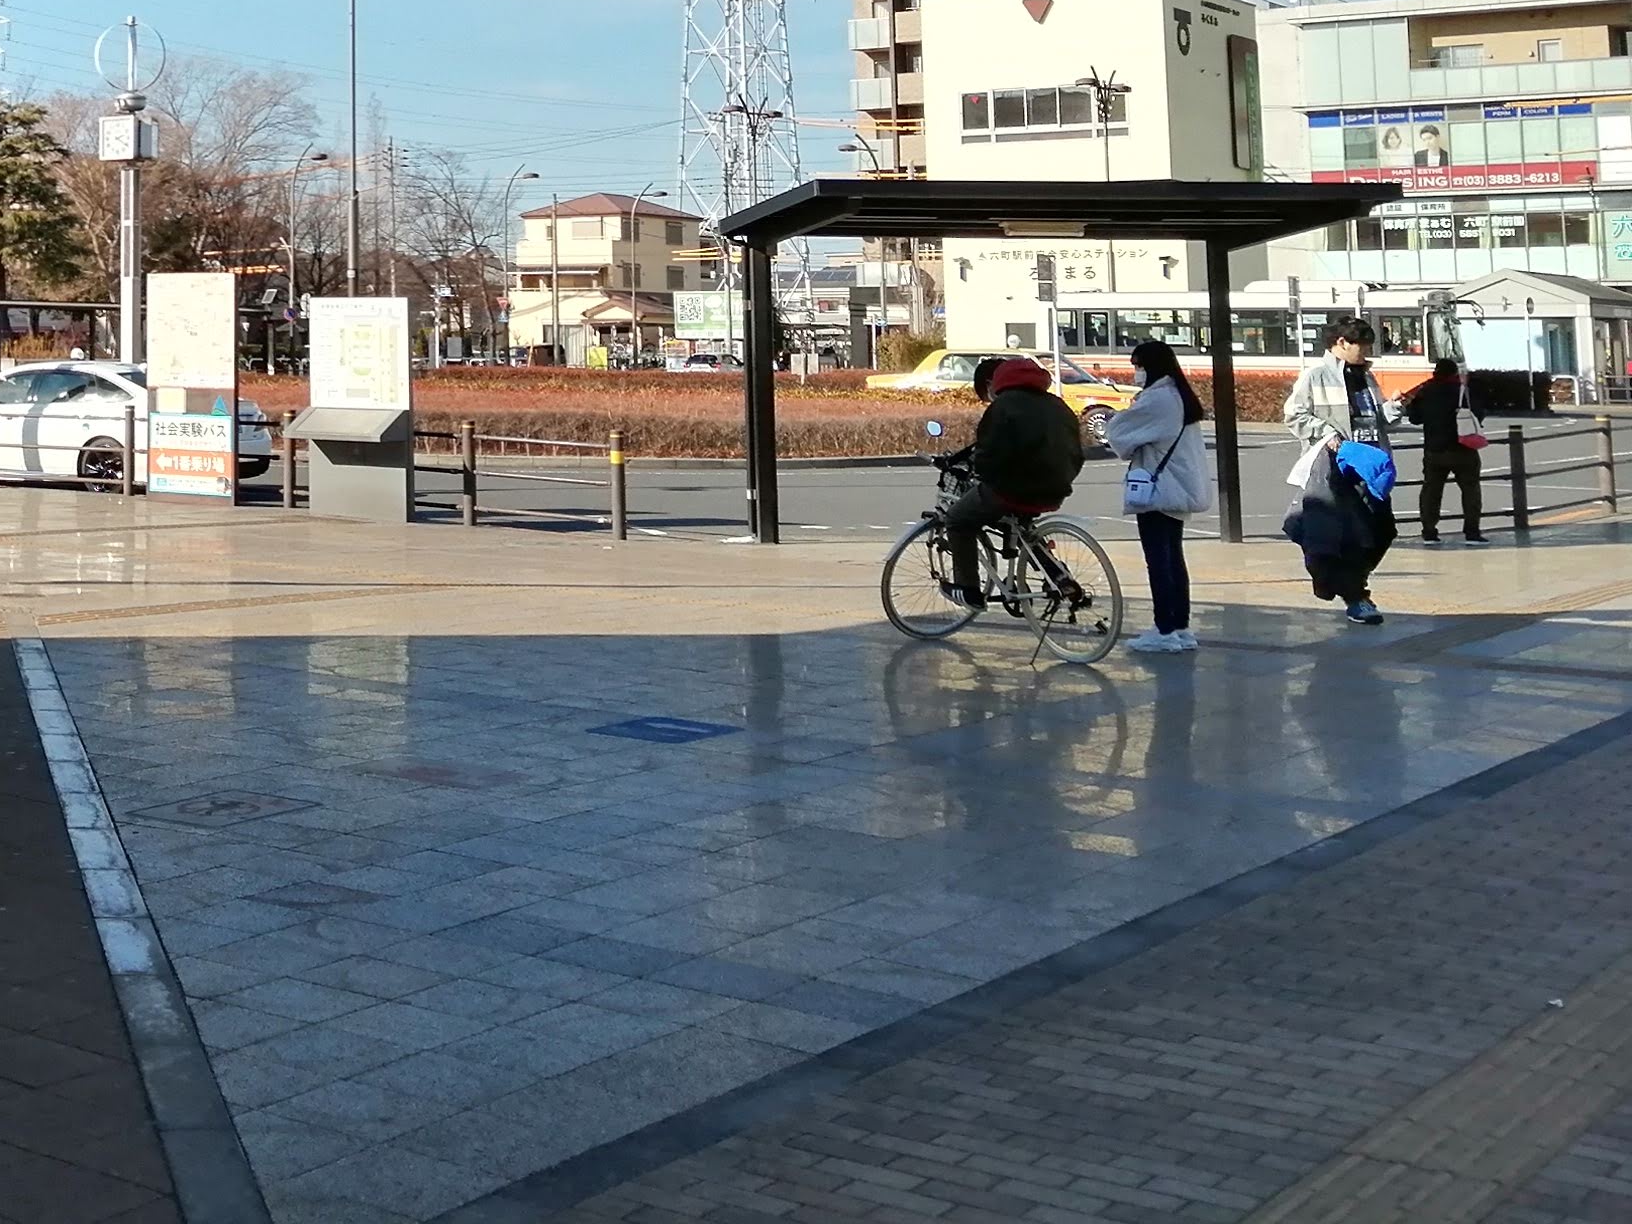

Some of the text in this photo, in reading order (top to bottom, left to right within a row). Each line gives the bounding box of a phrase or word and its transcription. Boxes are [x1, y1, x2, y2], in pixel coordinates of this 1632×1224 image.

[1391, 167, 1443, 176] HAIR ESTHE
[990, 249, 1148, 261] 六町駅前安心ステション
[1028, 266, 1097, 280] ろまる
[154, 421, 227, 438] 社会実験バス
[172, 455, 226, 474] 1番乗り場
